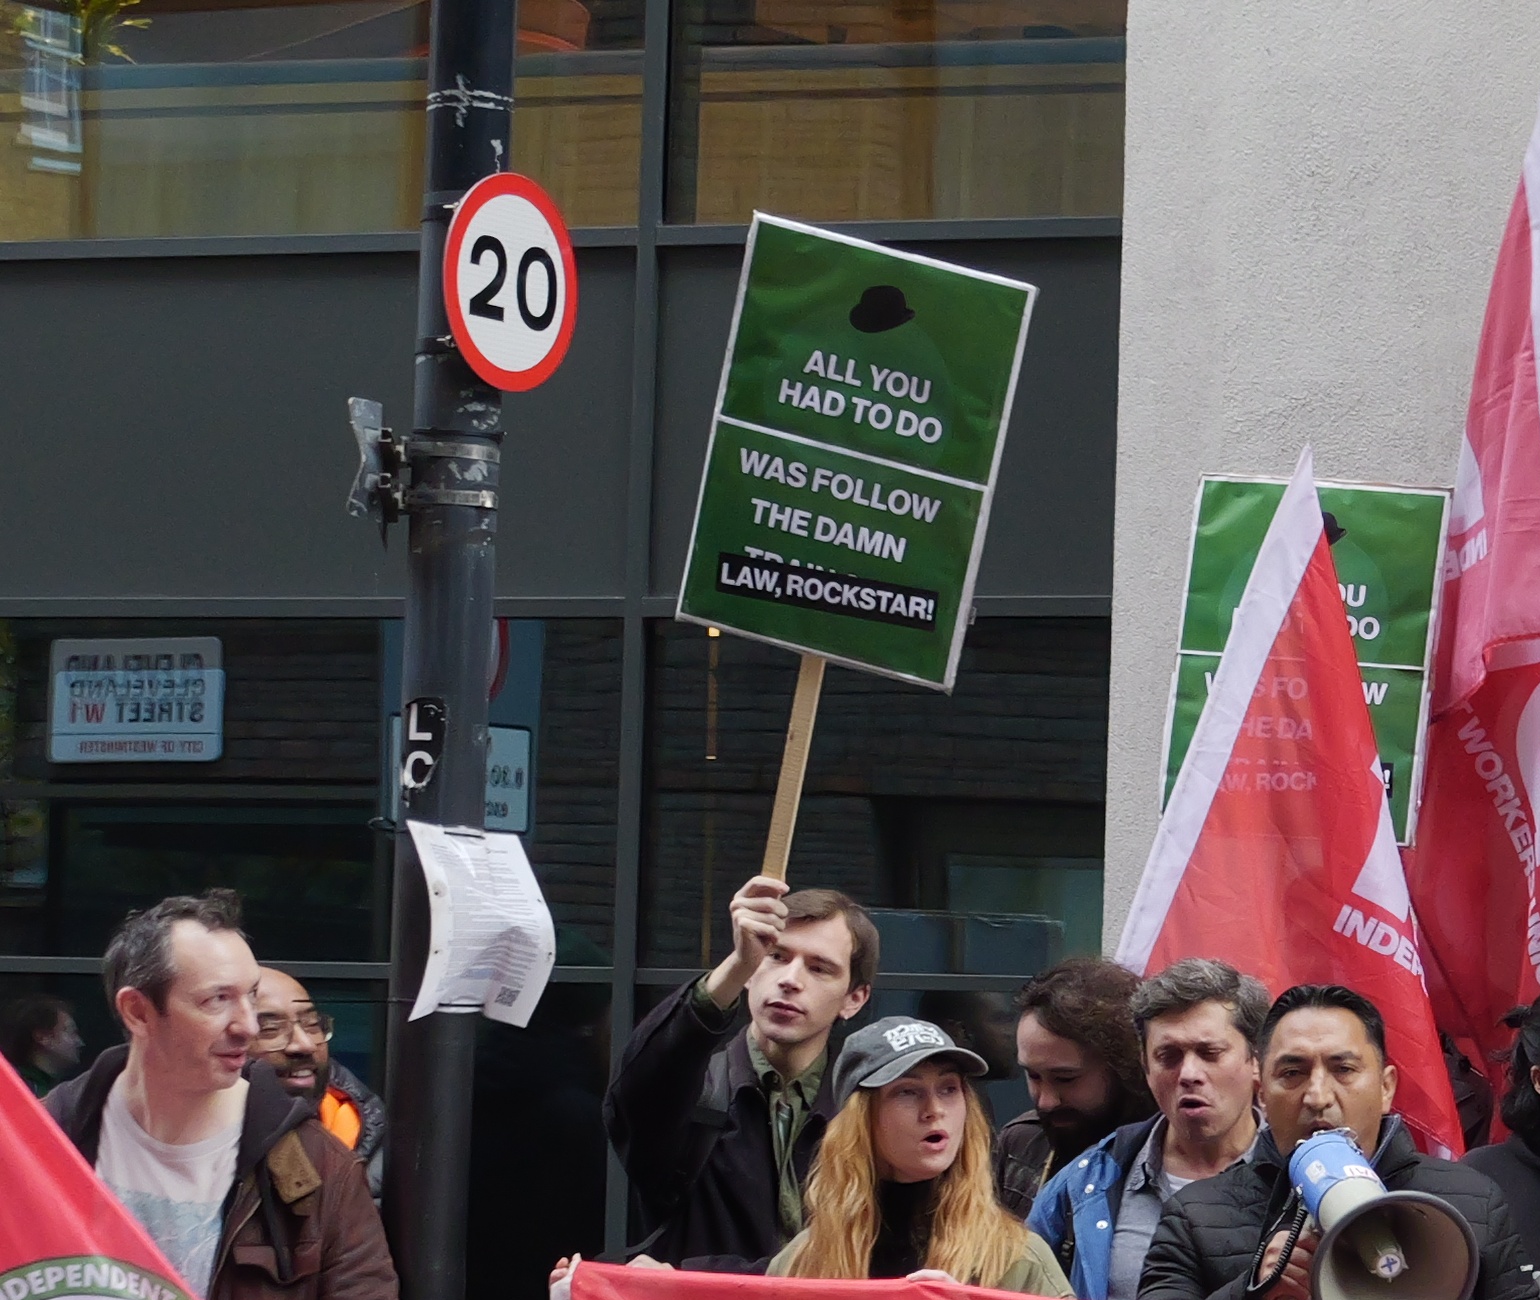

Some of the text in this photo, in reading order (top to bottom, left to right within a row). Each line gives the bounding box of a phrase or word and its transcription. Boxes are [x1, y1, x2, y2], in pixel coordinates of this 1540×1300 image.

[469, 235, 558, 331] 20
[804, 349, 931, 403] ALL YOU
[778, 379, 942, 444] HAD TO DO
[740, 447, 941, 524] WAS FOLLOW
[751, 498, 809, 538] THE
[814, 516, 907, 563] DAMN
[721, 561, 782, 599] LAW,
[786, 573, 935, 622] ROCKSTAR!
